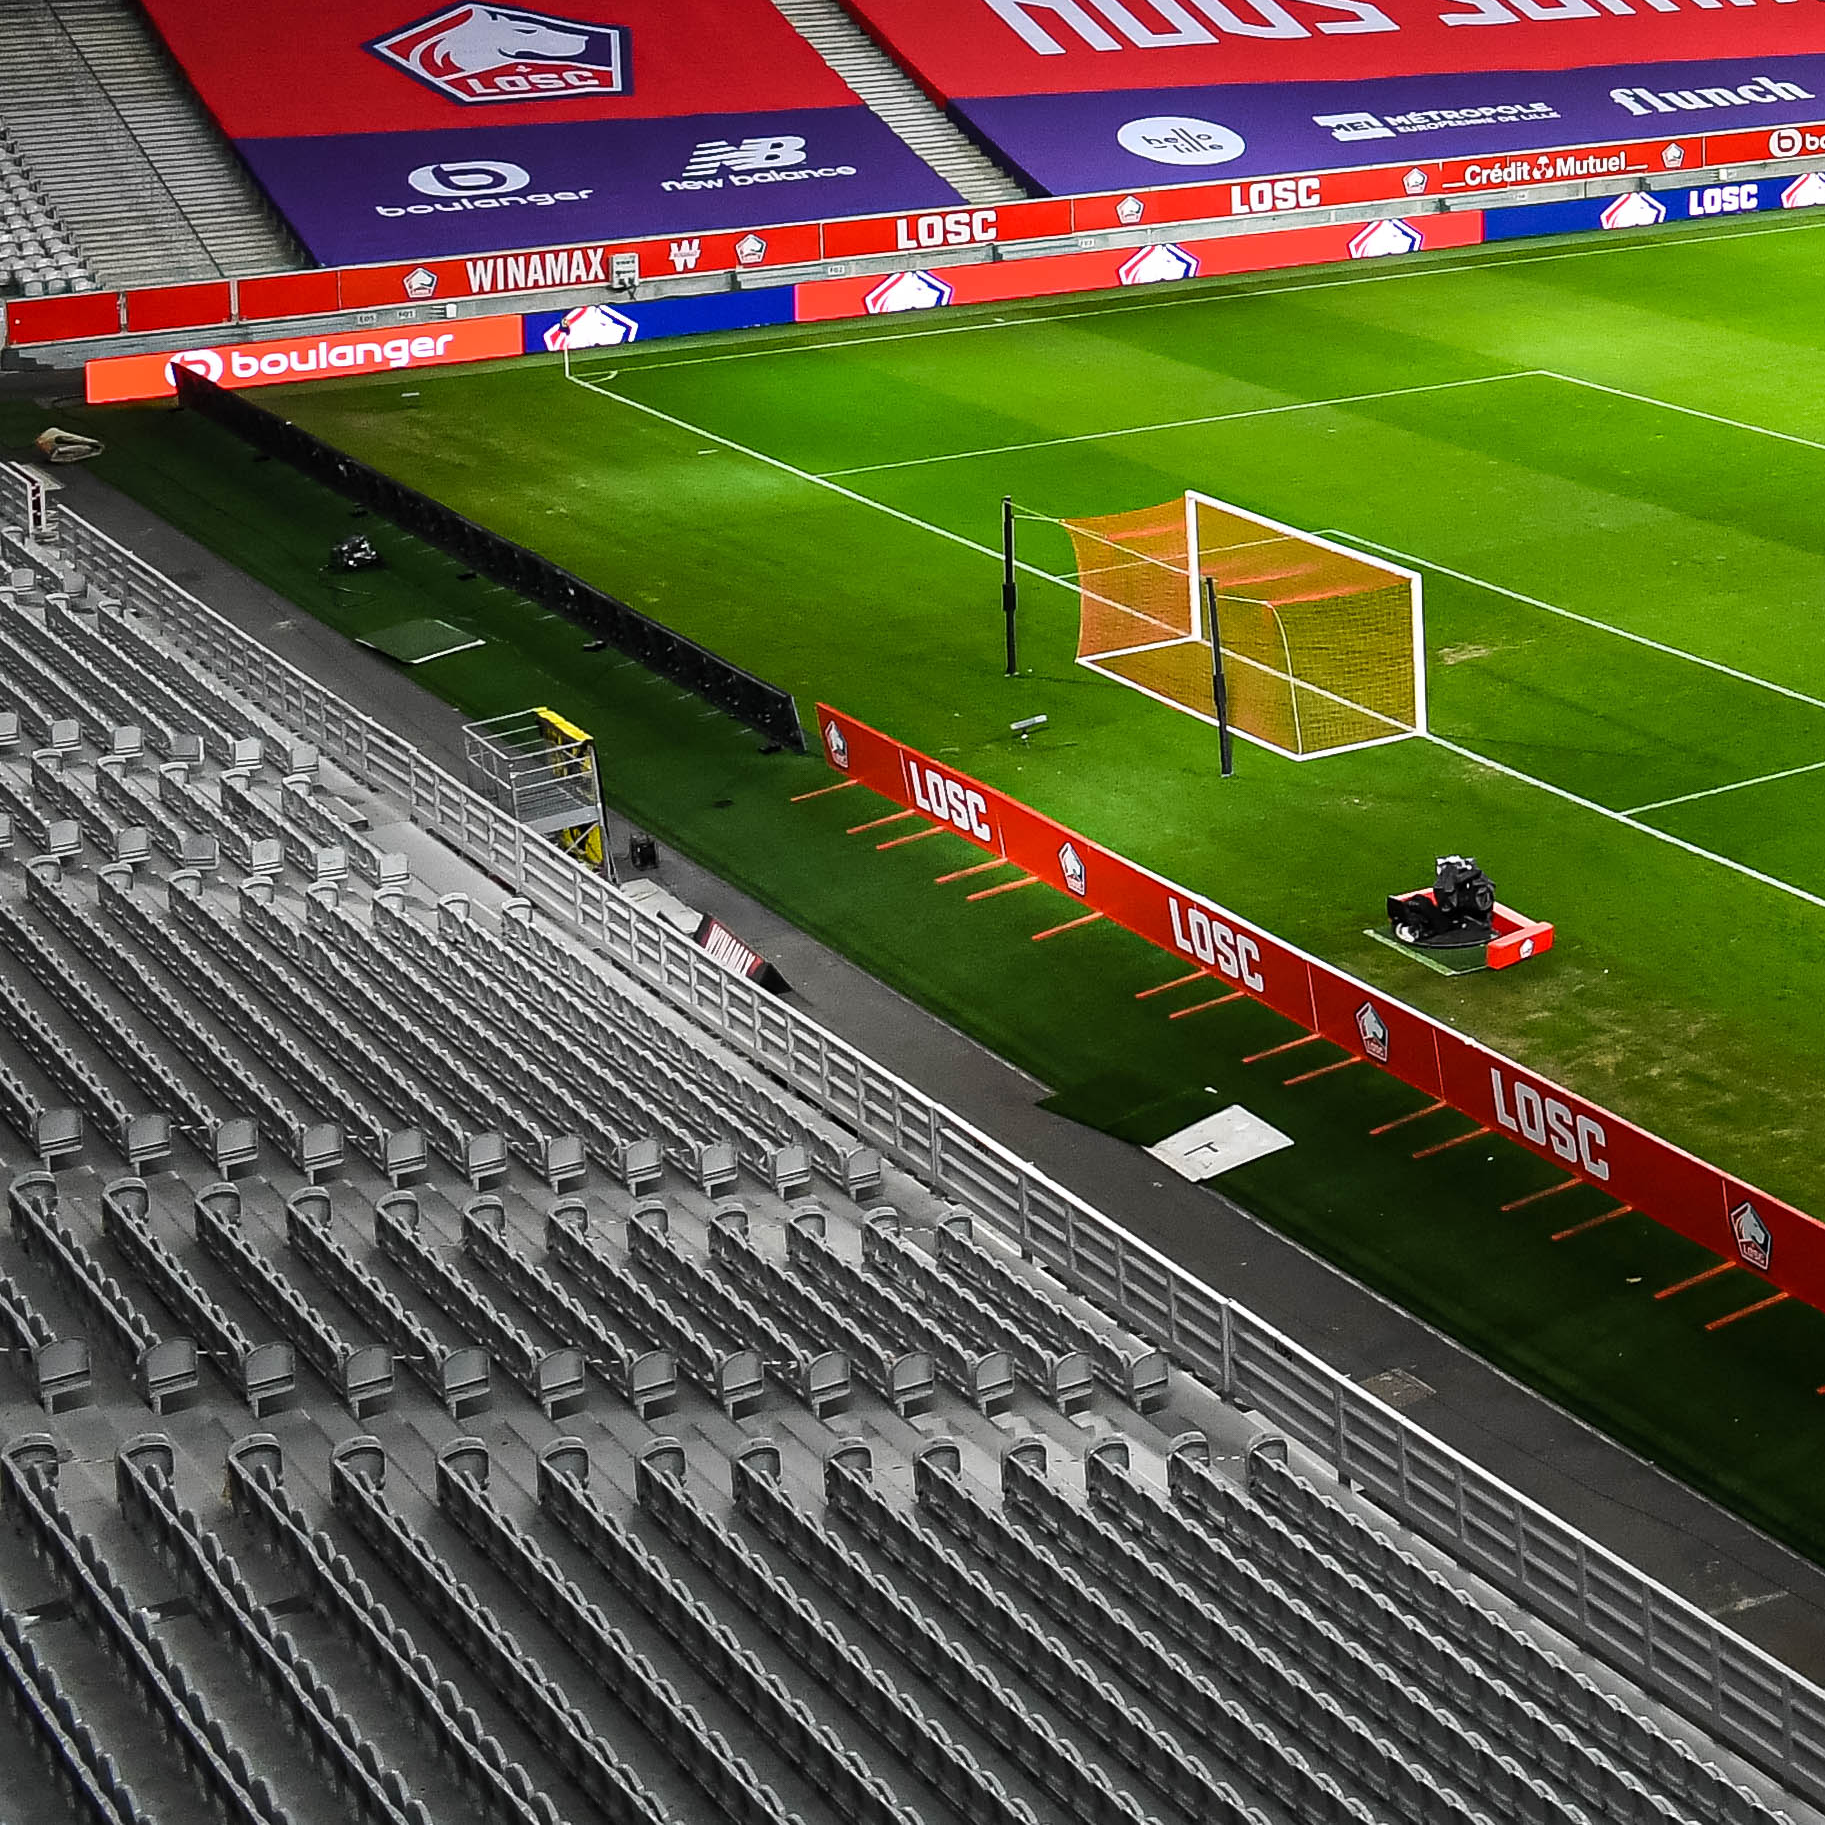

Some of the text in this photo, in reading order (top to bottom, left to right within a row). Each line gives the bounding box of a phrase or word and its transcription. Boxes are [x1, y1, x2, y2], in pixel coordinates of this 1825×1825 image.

[465, 70, 600, 95] LOSC
[1610, 77, 1815, 115] flunch
[1386, 103, 1554, 126] MÉTROPOLE
[1141, 128, 1212, 146] hello
[1173, 140, 1224, 154] lille
[661, 165, 857, 192] new balance
[1464, 152, 1627, 186] Crédit Mutuel
[375, 188, 594, 218] boulanger
[1231, 178, 1320, 213] LOSC
[1688, 184, 1758, 216] LOSC
[896, 210, 997, 248] LOSC
[466, 248, 606, 293] WINAMAX
[231, 334, 454, 376] boulanger
[909, 760, 991, 843] LOSC
[1168, 897, 1264, 994] LOSC
[1490, 1067, 1610, 1180] LOSC
[1742, 1243, 1765, 1264] LOSC
